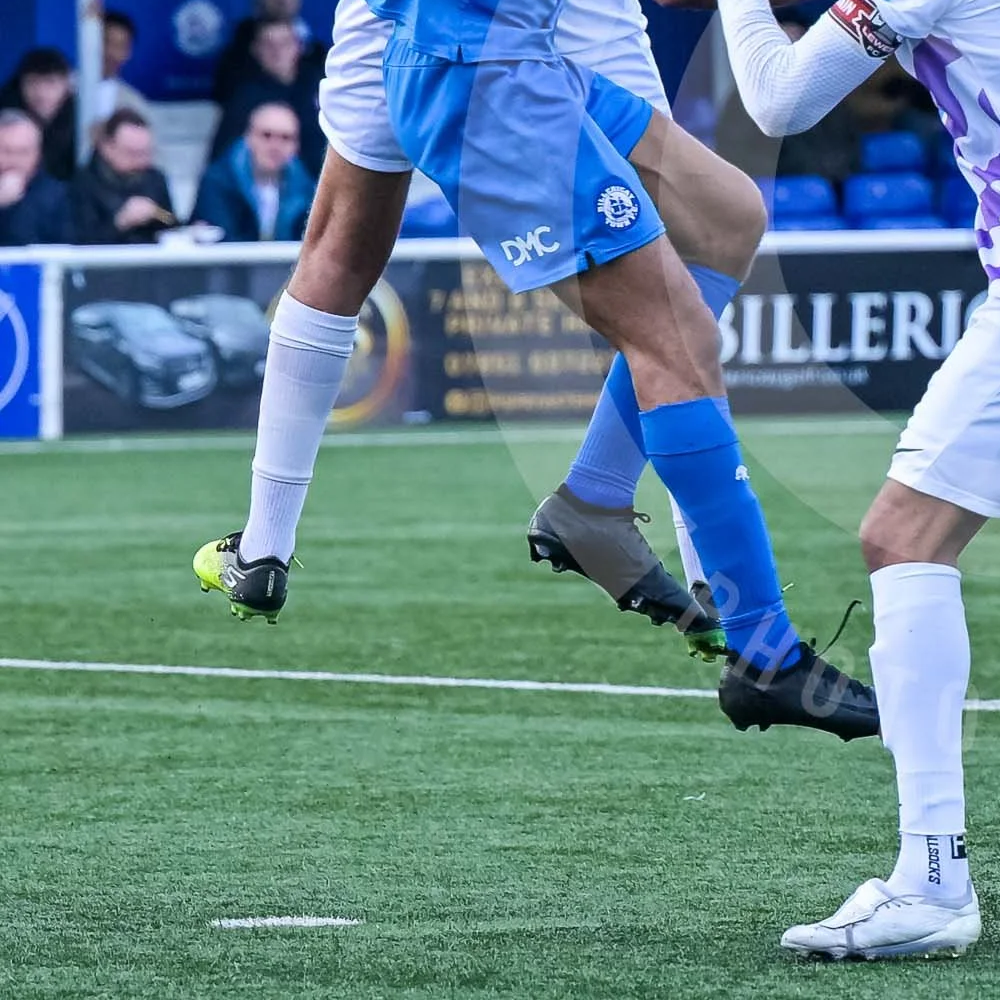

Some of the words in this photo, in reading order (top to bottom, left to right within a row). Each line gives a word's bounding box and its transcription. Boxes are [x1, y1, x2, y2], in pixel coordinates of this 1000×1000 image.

[500, 226, 560, 267] DMC
[718, 289, 988, 364] BILLERI
[926, 836, 941, 885] LLSOCKS
